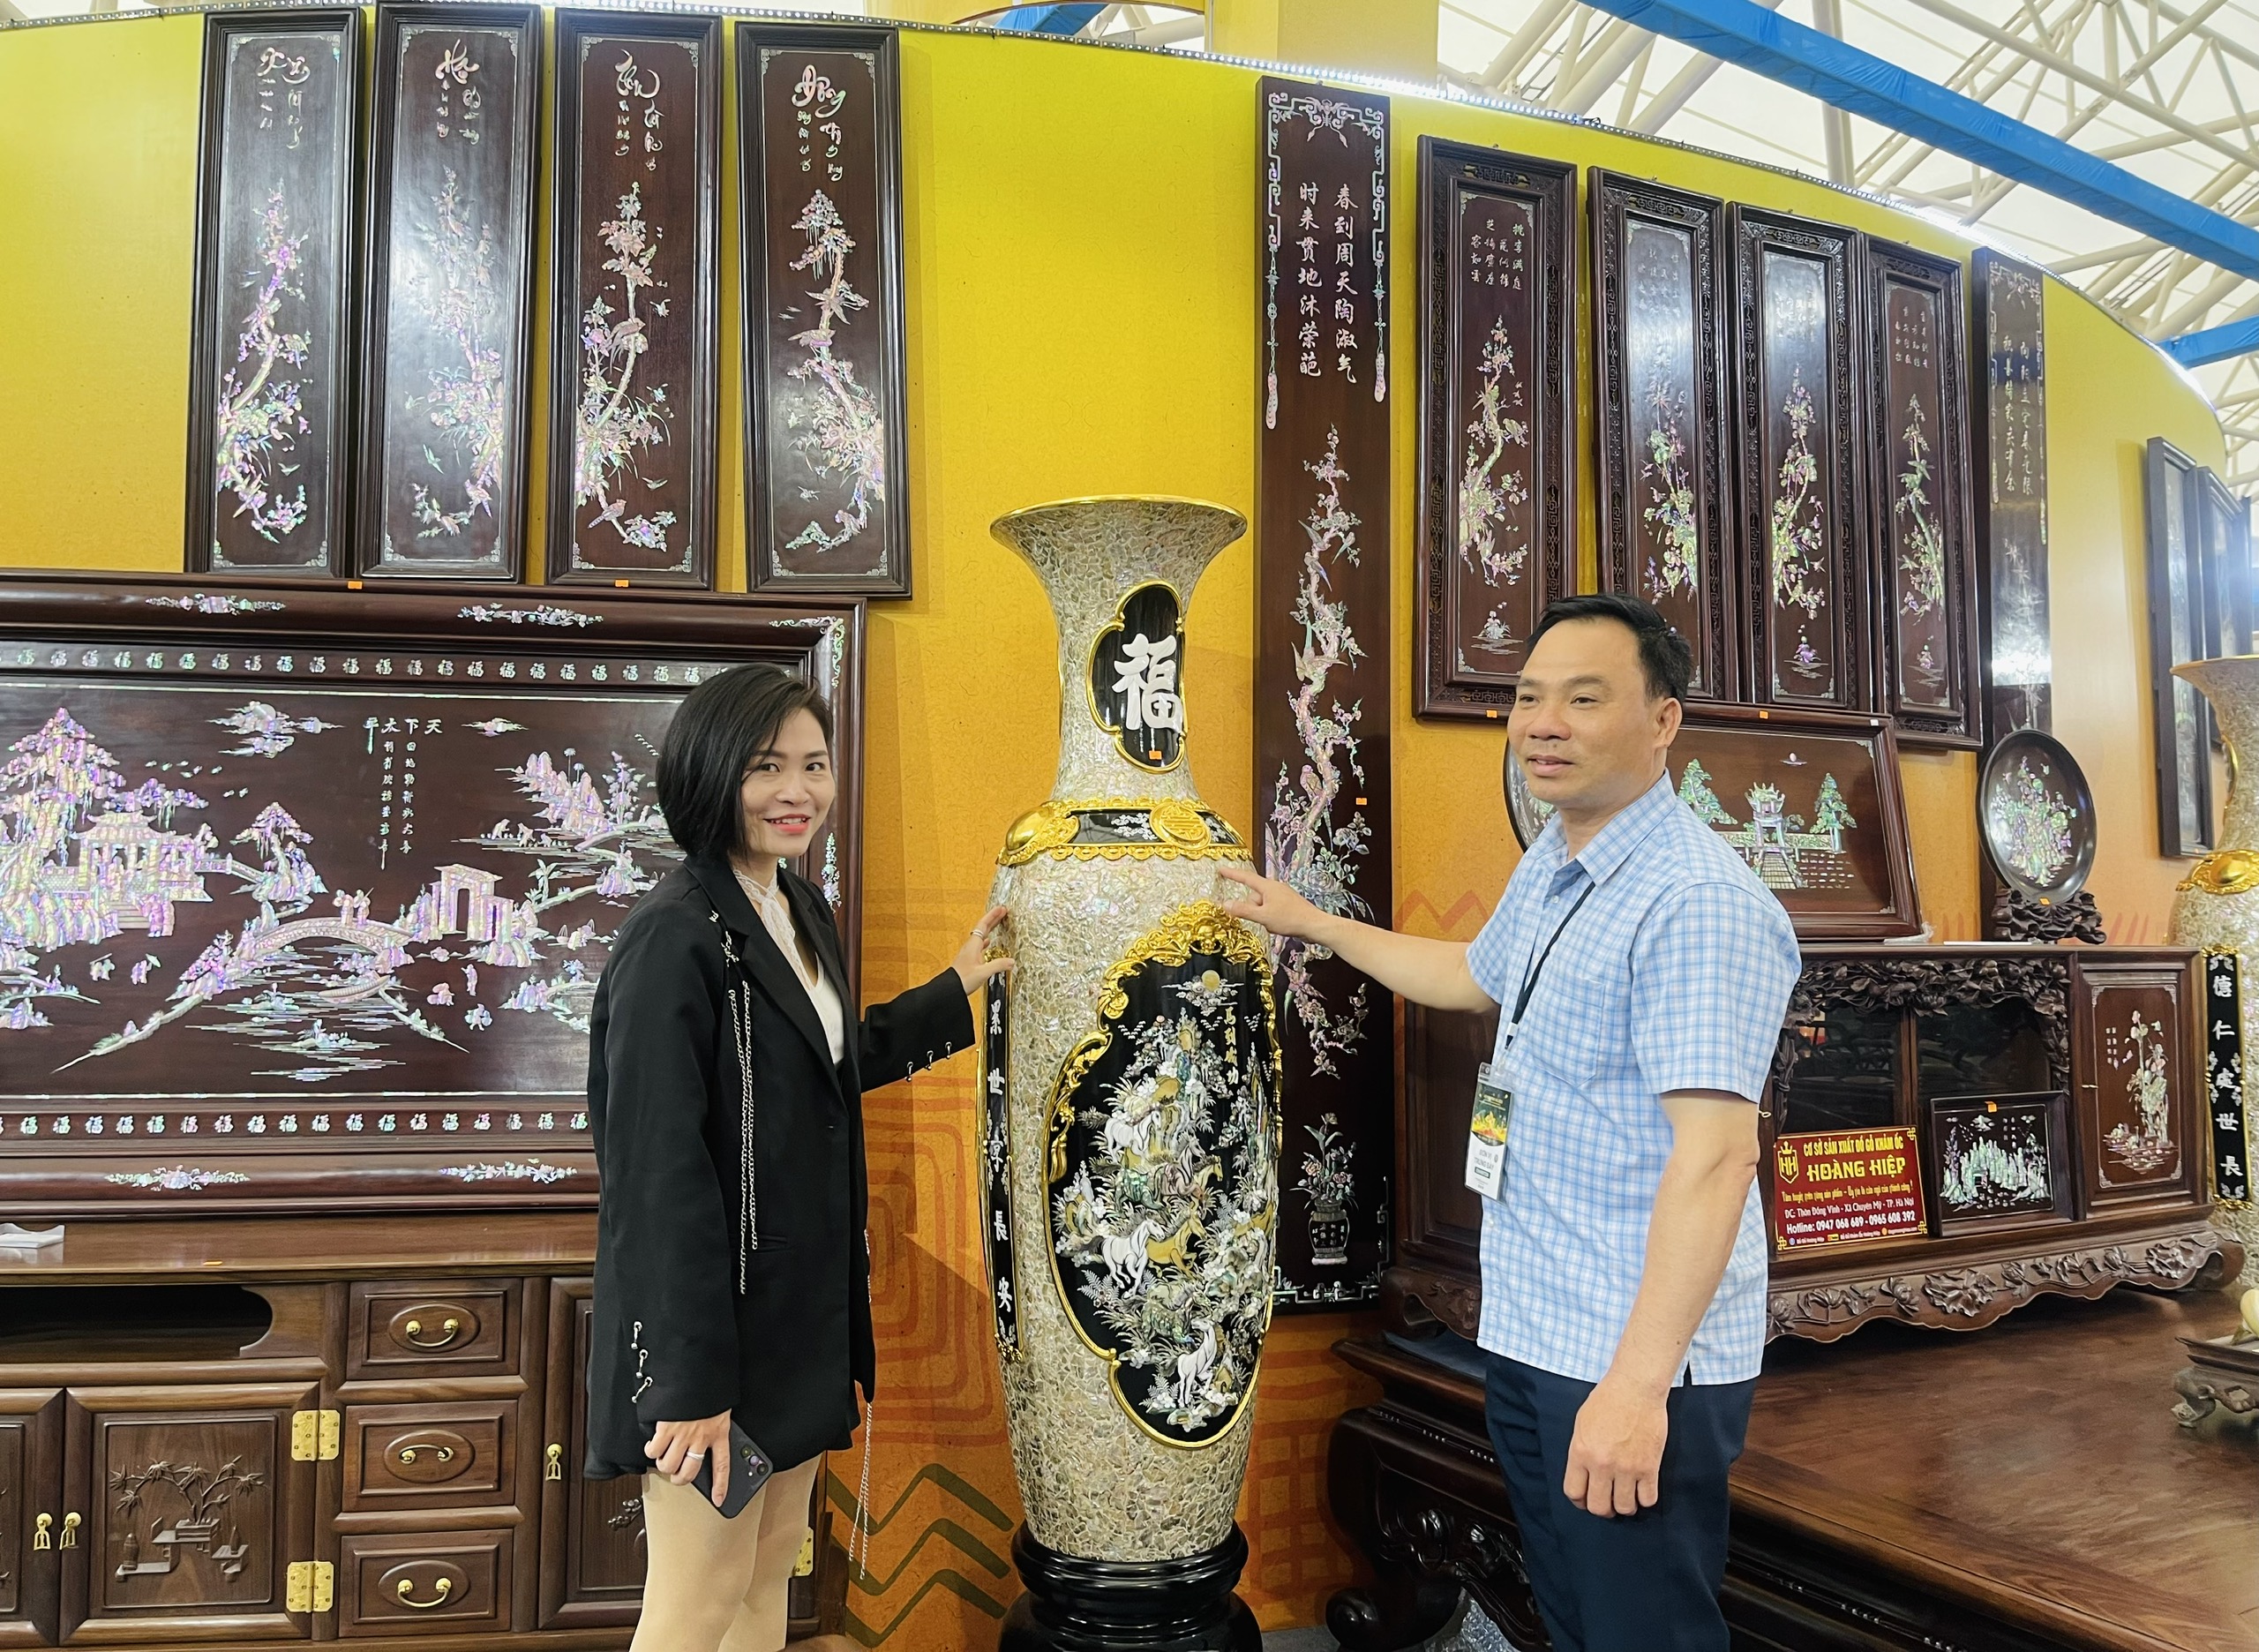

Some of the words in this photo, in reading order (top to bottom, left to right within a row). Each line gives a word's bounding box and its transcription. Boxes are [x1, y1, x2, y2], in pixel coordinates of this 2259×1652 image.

[1112, 633, 1183, 734] 福
[1806, 1159, 1865, 1182] HOÀNG
[1869, 1154, 1906, 1178] HIỆP
[1787, 1222, 1815, 1235] Hotline:
[1816, 1220, 1834, 1231] 0947
[1835, 1218, 1850, 1229] 068
[1850, 1216, 1864, 1228] 689
[1869, 1213, 1887, 1226] 0965
[1888, 1212, 1901, 1223] 608
[1902, 1210, 1916, 1222] 392
